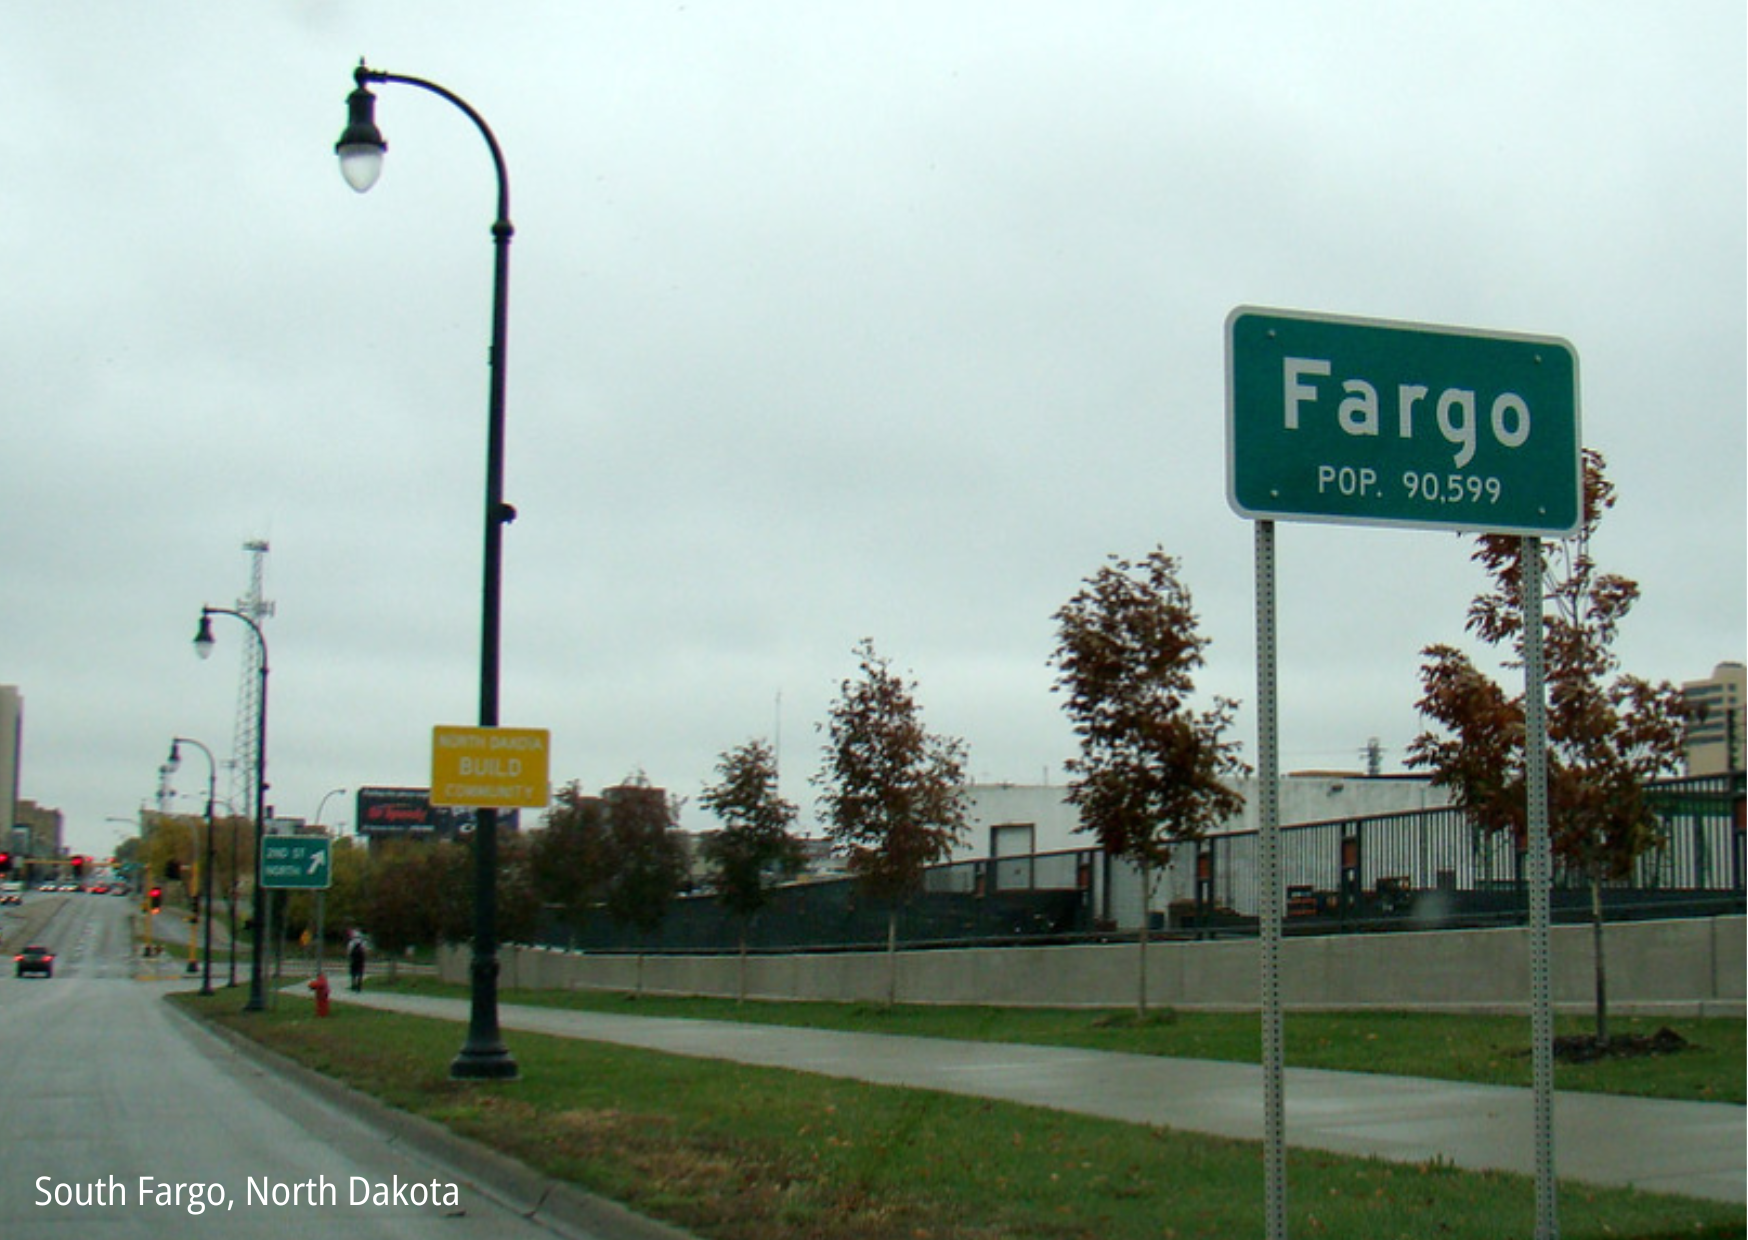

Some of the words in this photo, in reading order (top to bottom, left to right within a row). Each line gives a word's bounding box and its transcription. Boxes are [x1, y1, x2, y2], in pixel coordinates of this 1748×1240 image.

[1283, 357, 1531, 468] Fargo
[1319, 466, 1382, 498] POP.
[1403, 471, 1502, 504] 90,599
[438, 733, 486, 749] NORTH
[490, 735, 543, 751] DAKOTA
[459, 756, 522, 777] BUILD
[445, 783, 535, 801] COMMUNITY
[266, 847, 289, 859] 2ND
[292, 847, 305, 859] ST
[265, 865, 302, 877] NORTH
